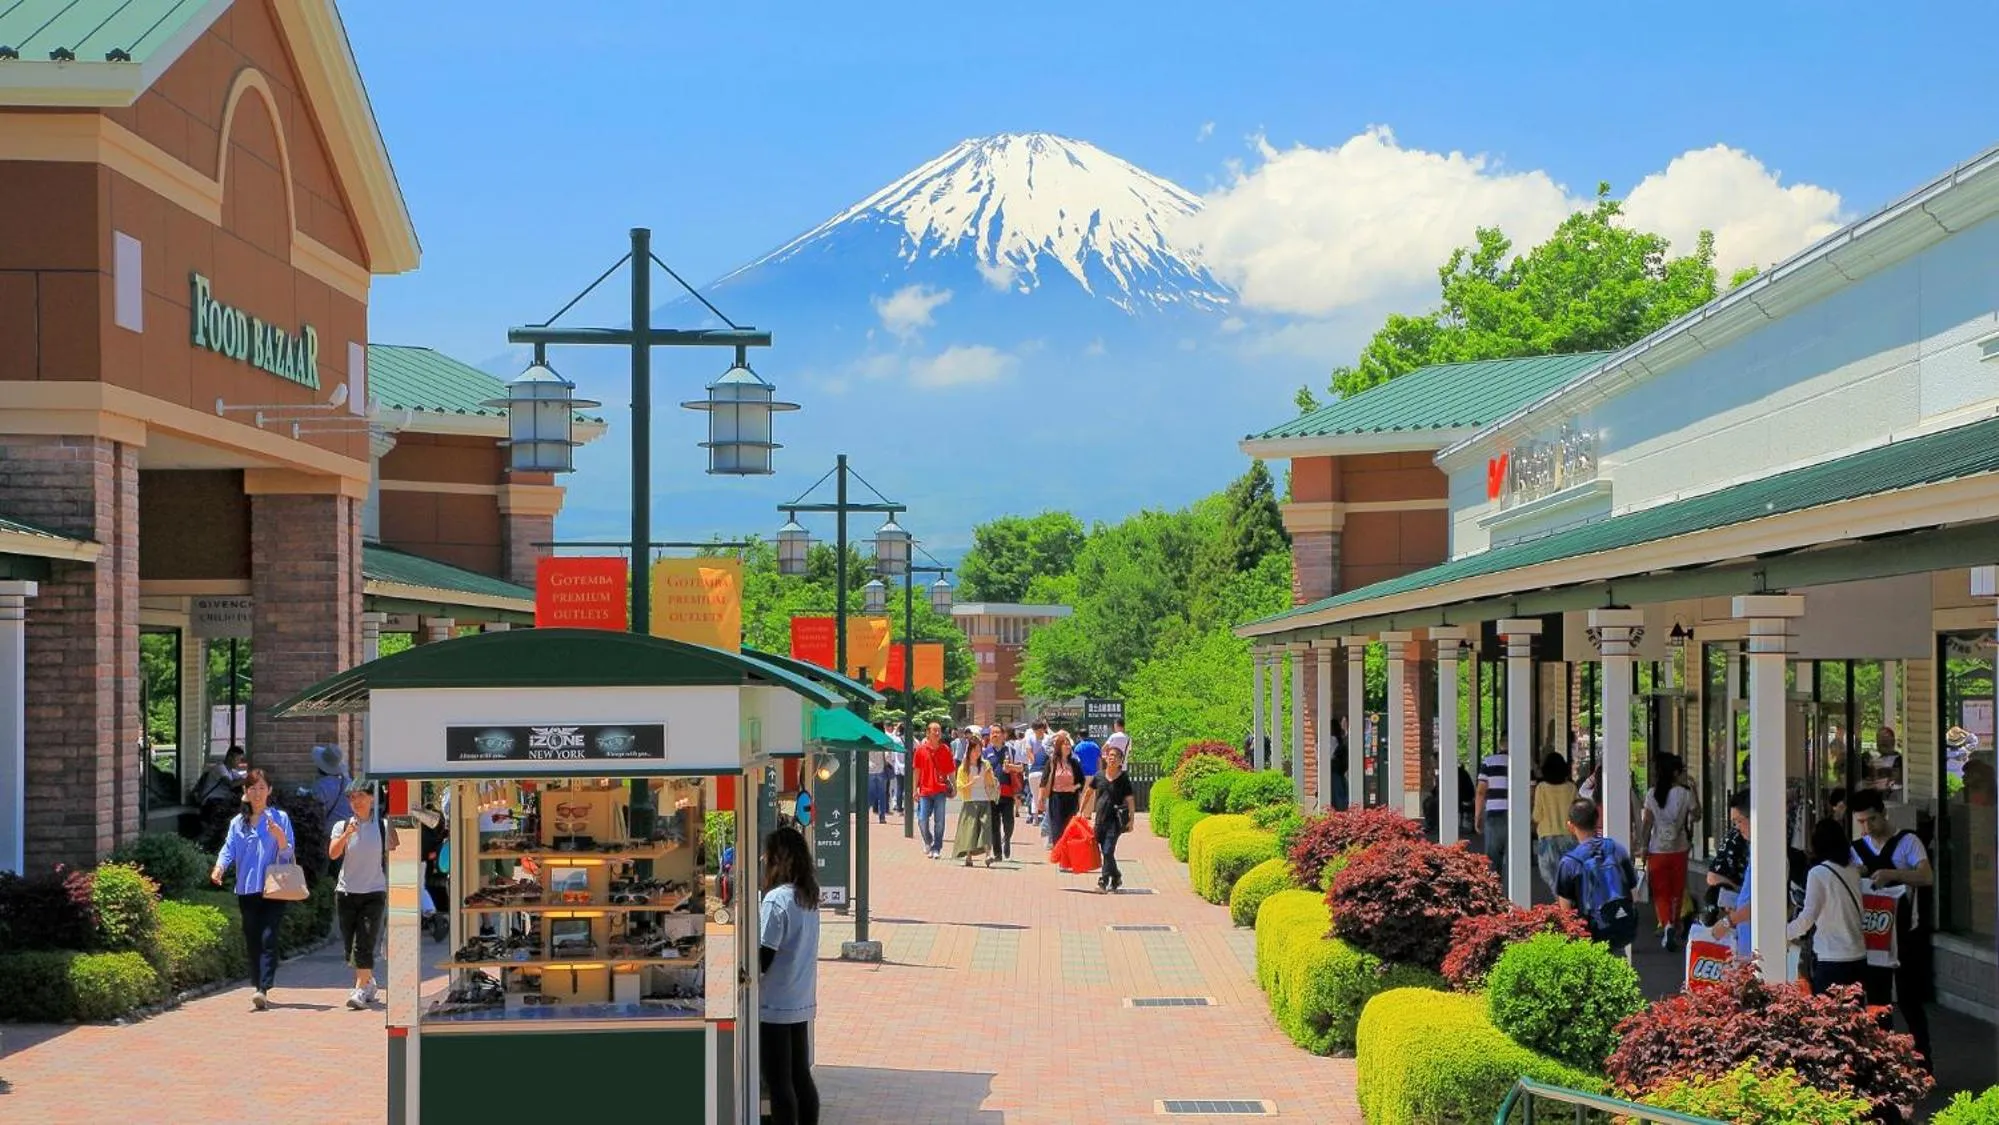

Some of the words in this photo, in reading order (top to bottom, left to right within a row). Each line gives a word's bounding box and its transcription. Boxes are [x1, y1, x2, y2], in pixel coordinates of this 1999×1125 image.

[192, 272, 249, 361] FOOD
[252, 316, 321, 391] BAZAAR
[551, 572, 614, 587] GOTEMBA
[666, 575, 729, 590] GOTEMBA
[552, 591, 612, 603] PREMIUM
[668, 594, 728, 606] PREMIUM
[553, 609, 610, 621] OUTLETS
[668, 611, 725, 623] OUTLETS
[528, 750, 554, 760] NEW
[555, 750, 585, 760] YORK
[1862, 911, 1889, 931] EGO
